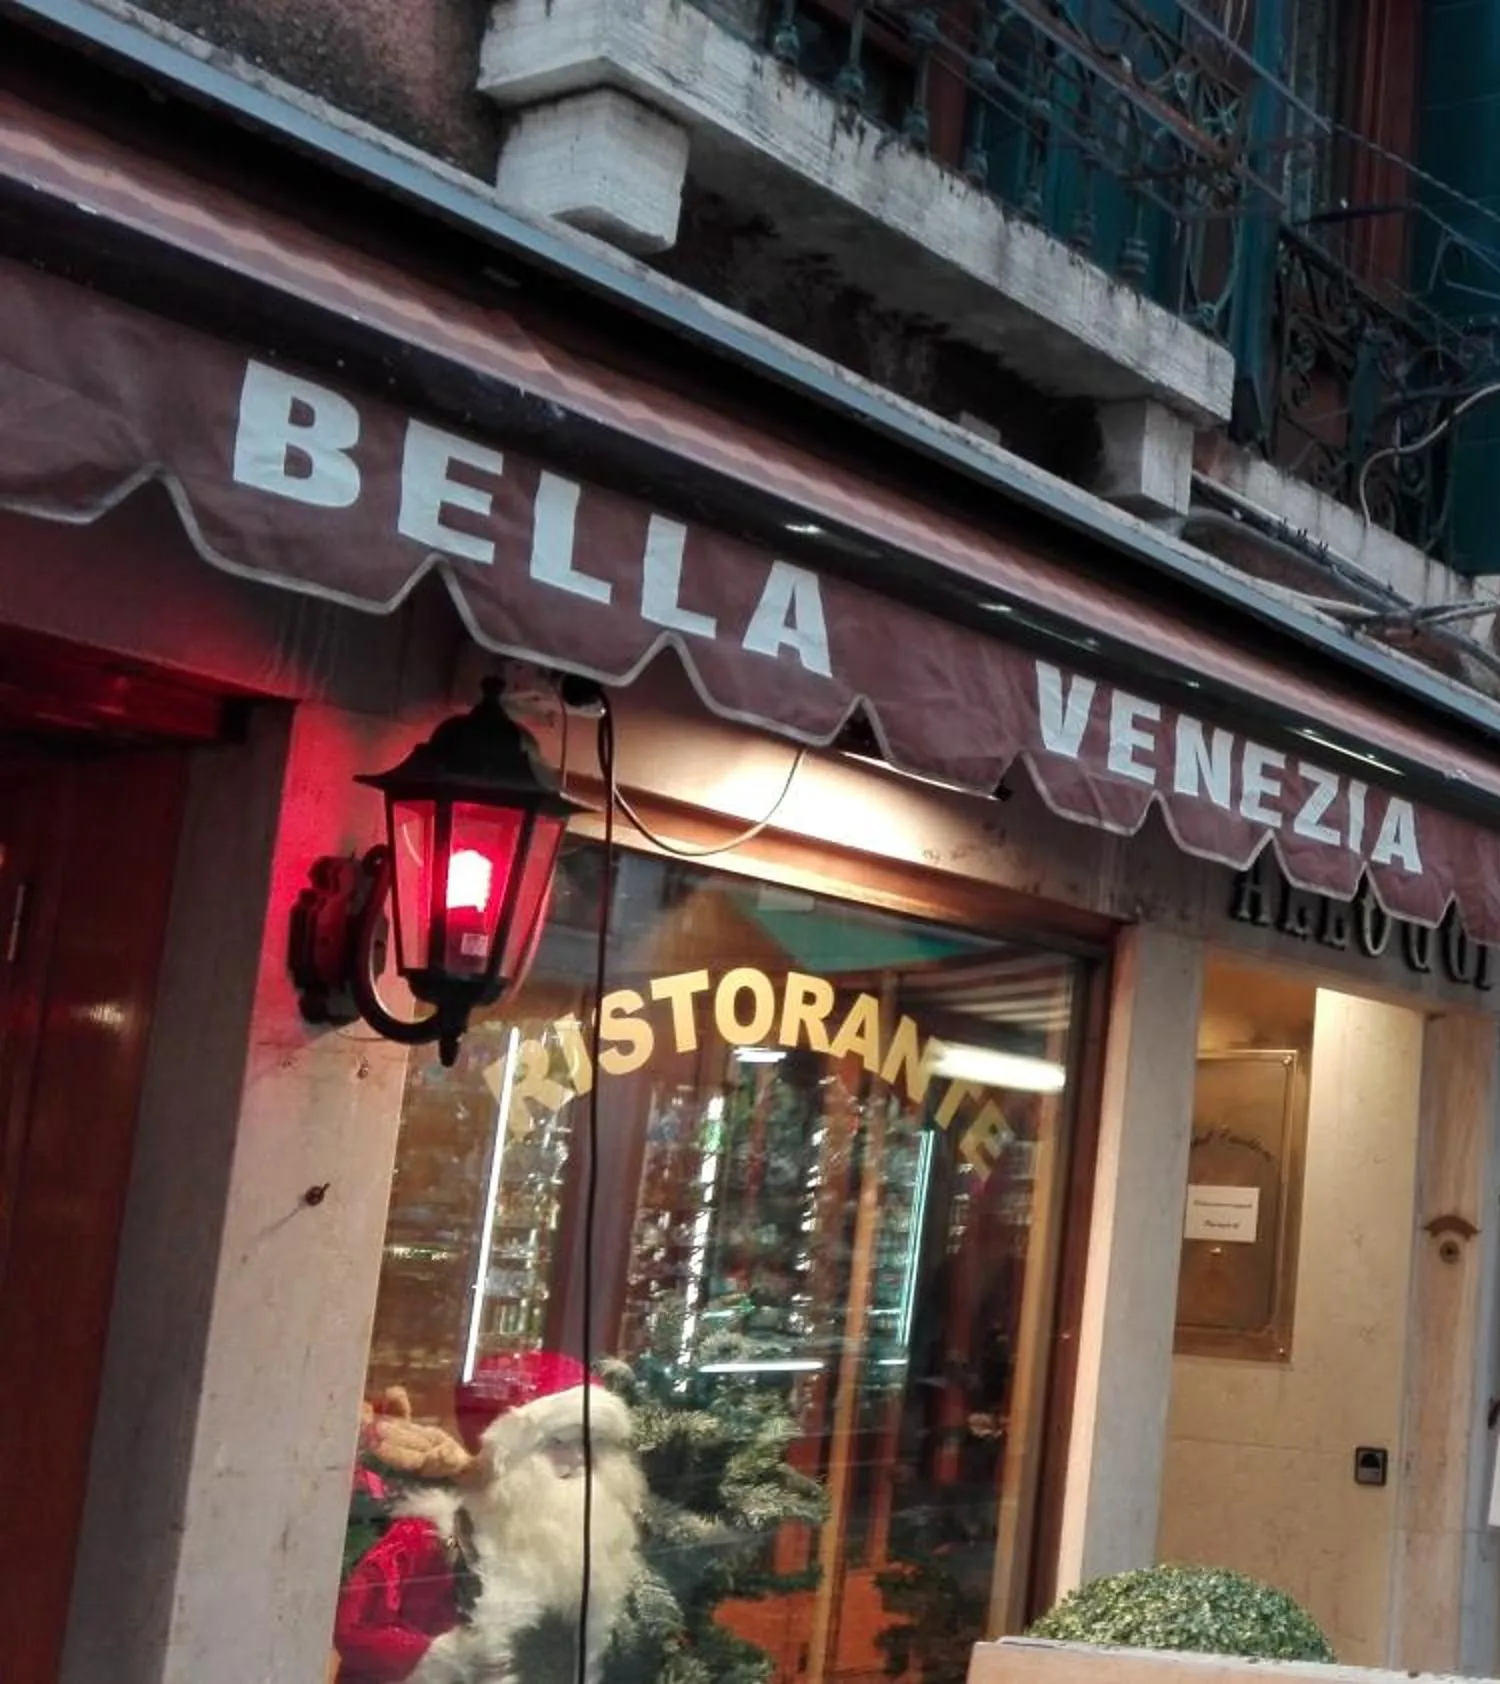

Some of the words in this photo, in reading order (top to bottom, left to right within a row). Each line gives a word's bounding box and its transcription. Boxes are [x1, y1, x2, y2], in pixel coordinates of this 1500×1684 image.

[233, 359, 832, 678] BELLA
[1035, 659, 1423, 875] VENEZIA
[483, 966, 1016, 1179] RISTORANTE
